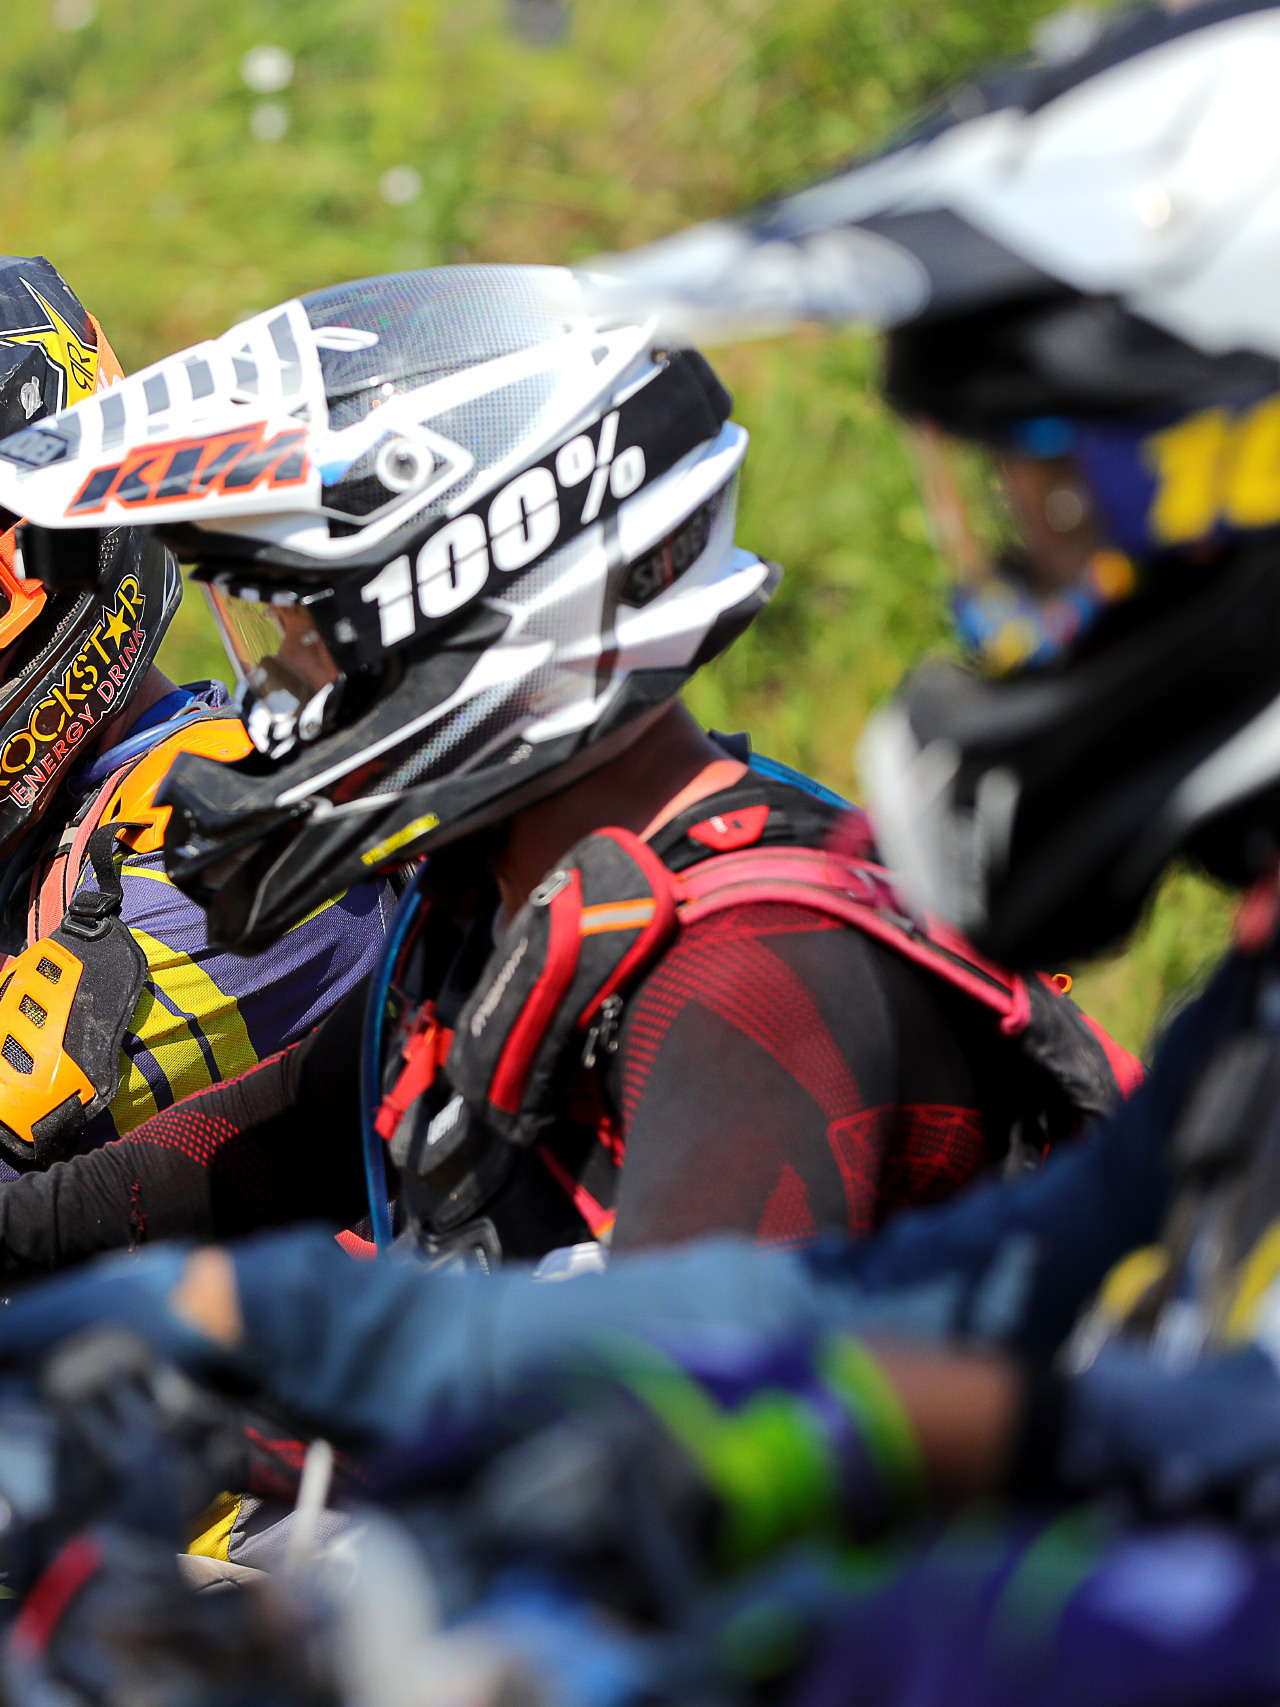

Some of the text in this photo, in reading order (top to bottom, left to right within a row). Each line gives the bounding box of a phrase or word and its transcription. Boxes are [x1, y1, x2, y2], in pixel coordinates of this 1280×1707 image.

[63, 421, 310, 518] KTM
[360, 409, 647, 648] 100%
[9, 621, 144, 804] ENERGY DRINK
